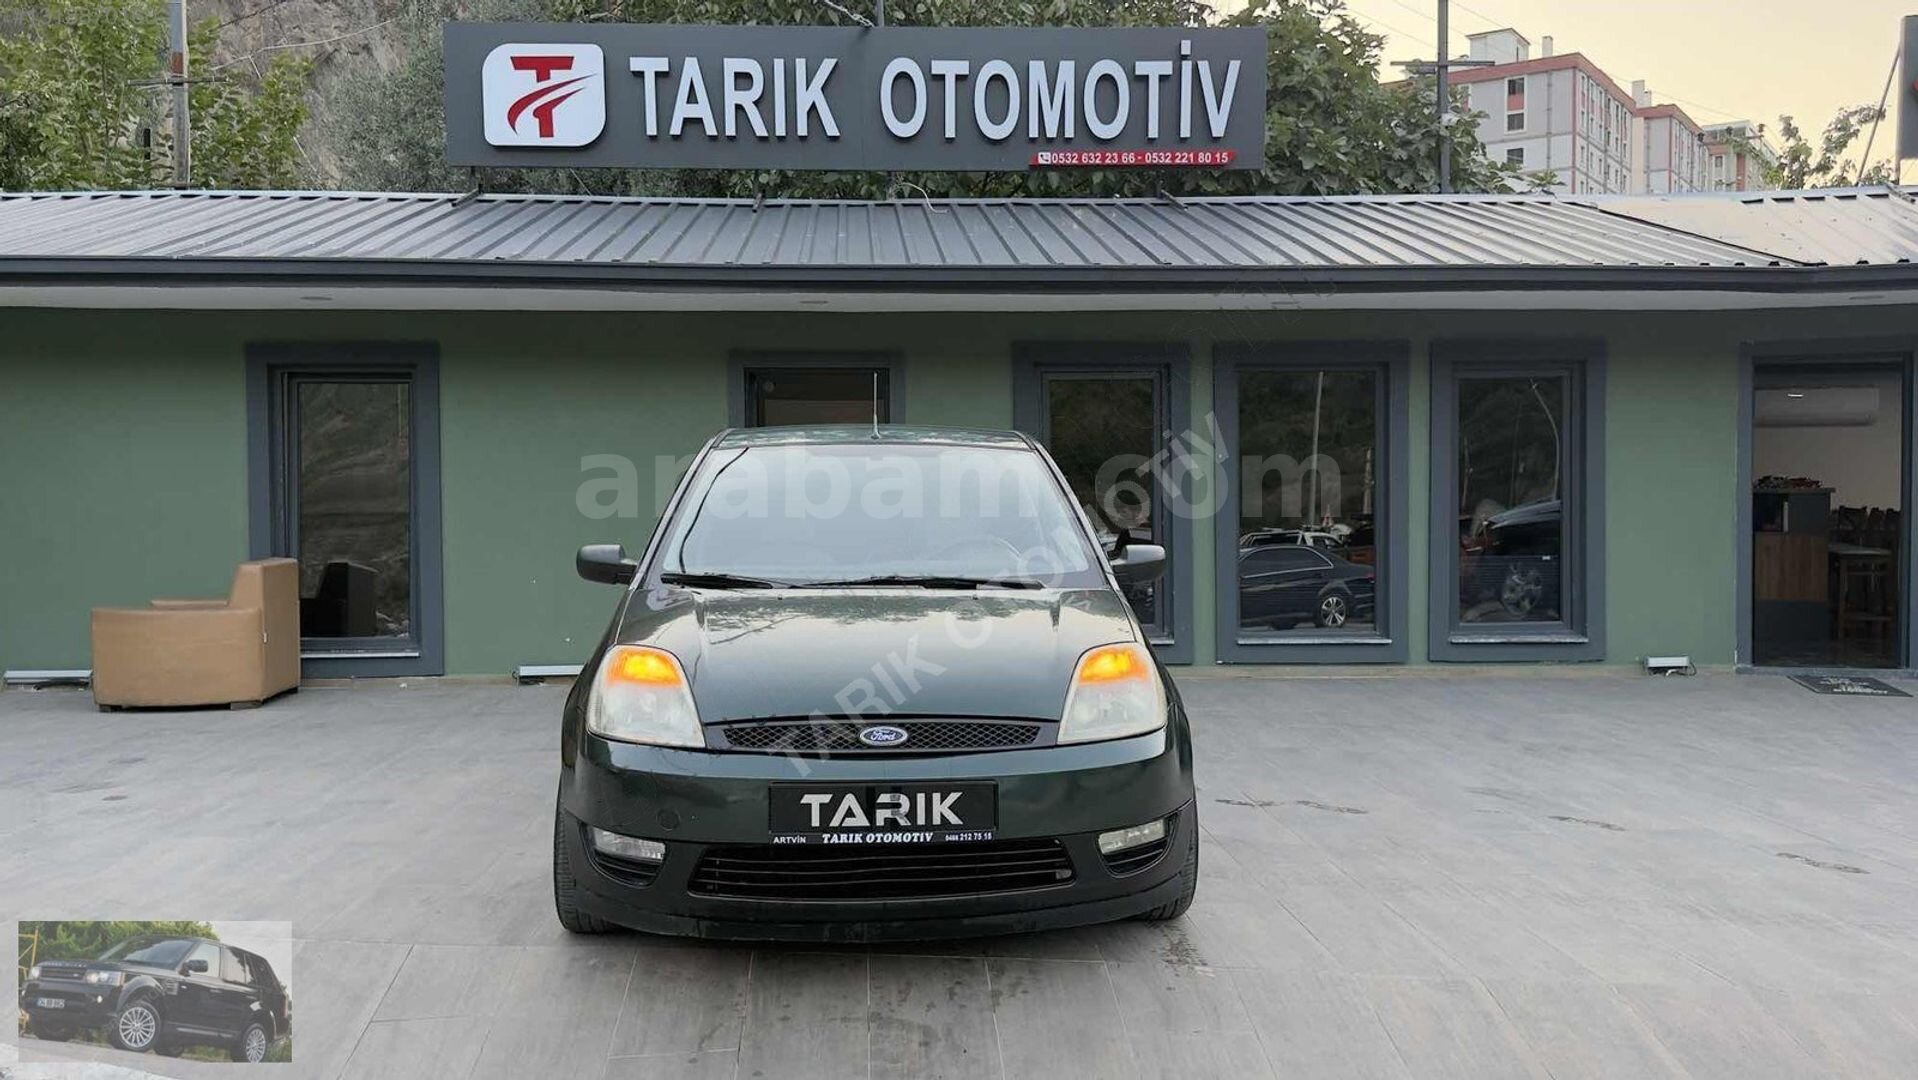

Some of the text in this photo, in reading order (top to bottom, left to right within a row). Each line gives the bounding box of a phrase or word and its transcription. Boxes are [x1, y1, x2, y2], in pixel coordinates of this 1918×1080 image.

[630, 39, 1241, 139] TARIK OTOMOTİV
[1051, 152, 1079, 164] 0532
[1082, 152, 1102, 164] 632
[1105, 152, 1119, 164] 23
[1121, 152, 1136, 164] 66
[1145, 152, 1172, 164] 0532
[1175, 152, 1194, 164] 221
[1197, 152, 1212, 164] 80
[1215, 152, 1229, 164] 15
[800, 792, 964, 827] TARIK
[773, 835, 807, 845] ARTVİN
[822, 833, 863, 844] TARIK
